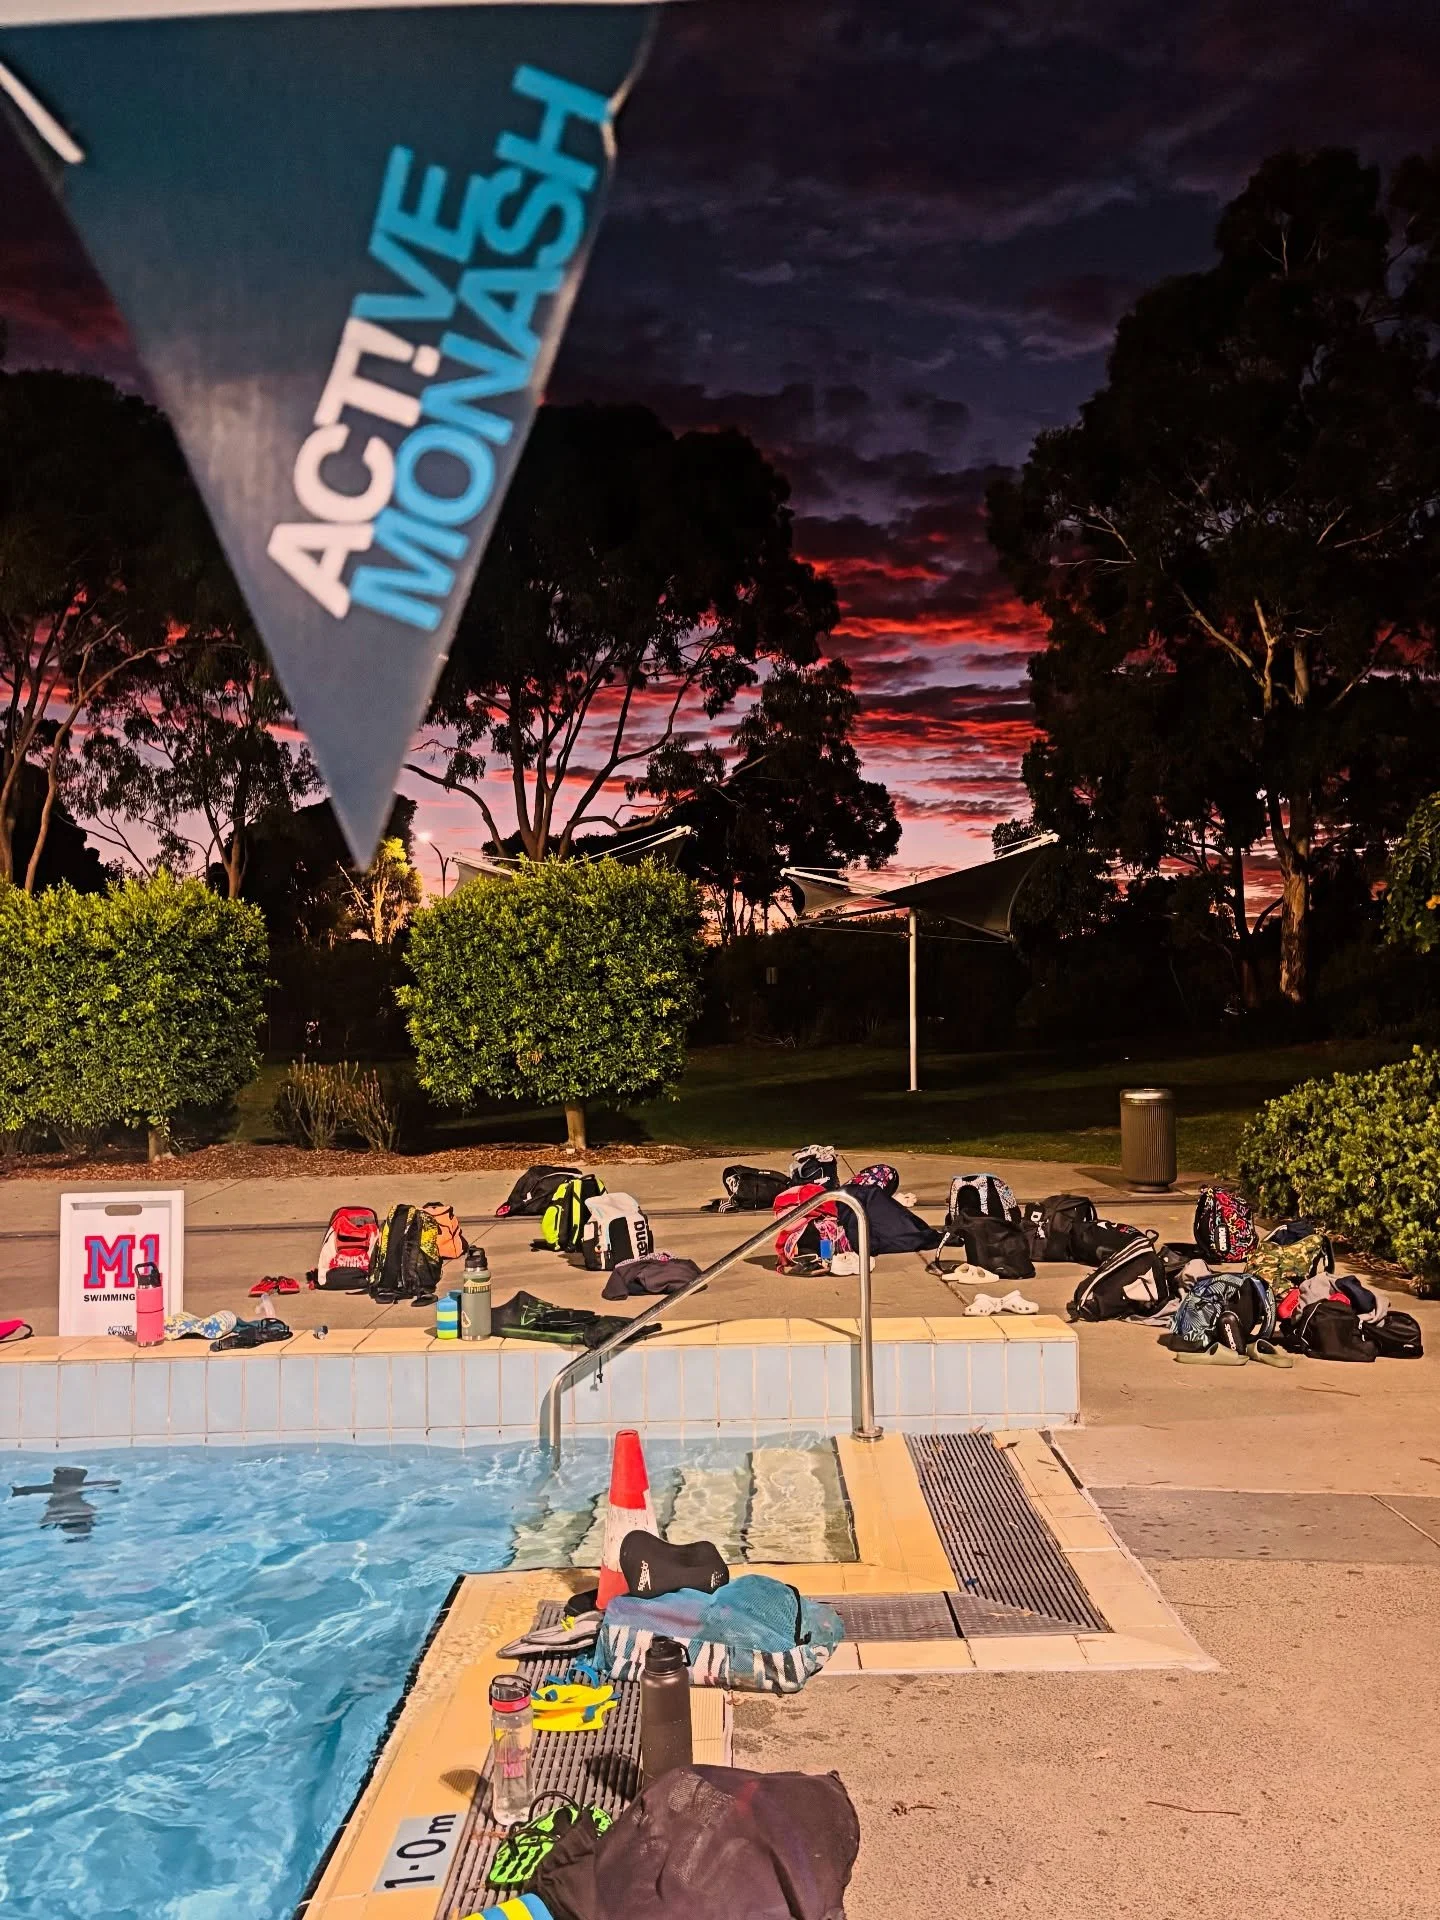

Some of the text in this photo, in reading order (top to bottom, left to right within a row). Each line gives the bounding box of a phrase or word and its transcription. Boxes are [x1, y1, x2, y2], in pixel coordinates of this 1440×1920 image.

[349, 64, 614, 633] MONASH
[83, 1234, 163, 1289] M1
[634, 1220, 648, 1257] rena
[83, 1293, 136, 1302] SWIMMING
